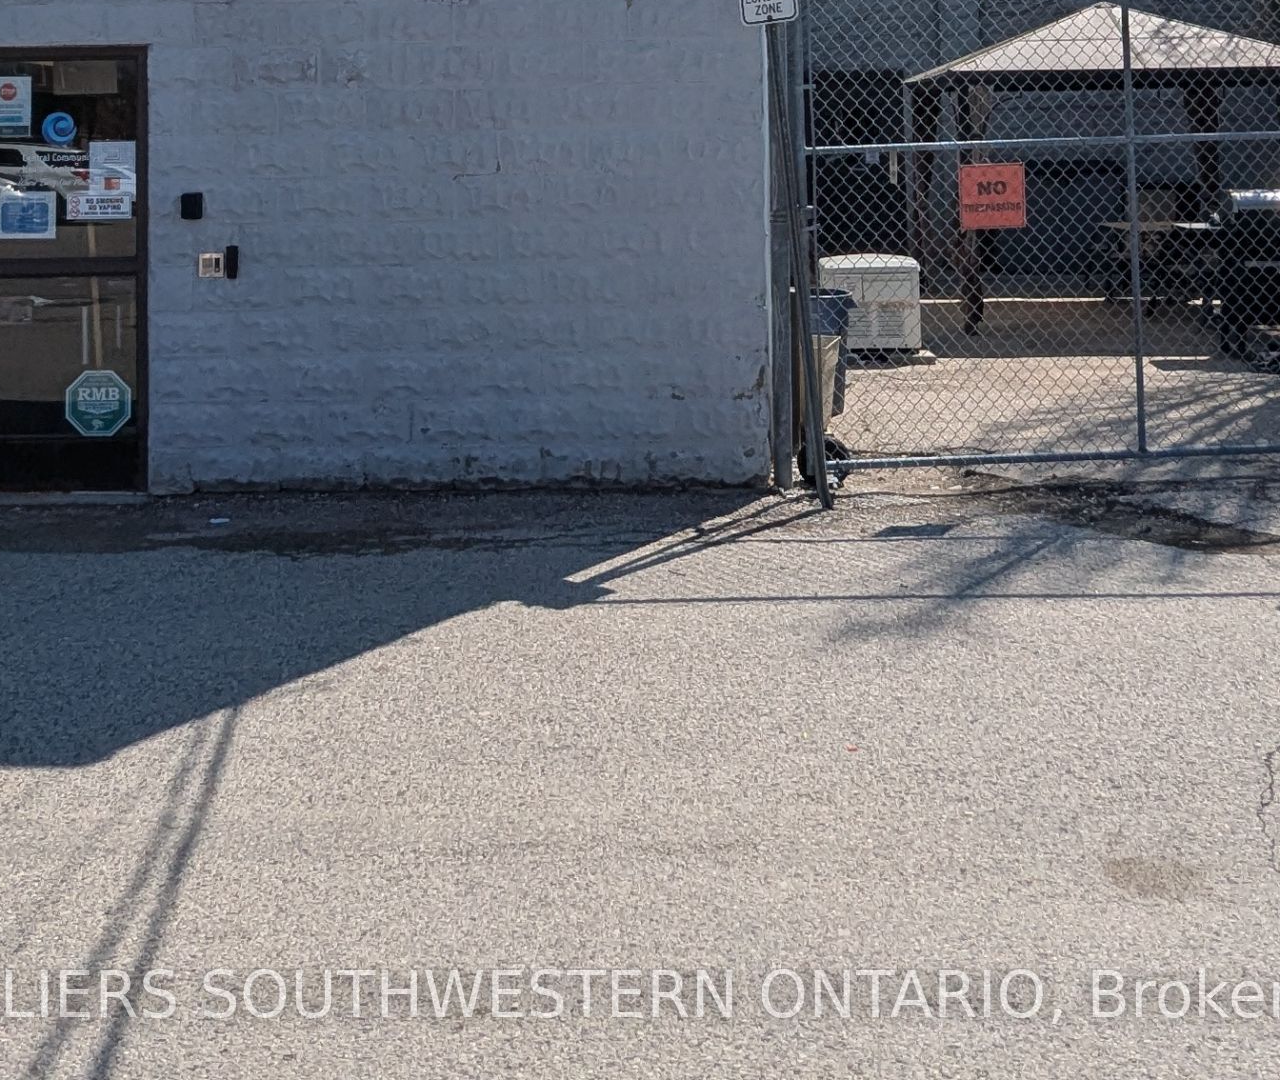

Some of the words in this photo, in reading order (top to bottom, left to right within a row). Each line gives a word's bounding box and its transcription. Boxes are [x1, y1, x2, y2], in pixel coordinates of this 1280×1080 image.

[754, 2, 783, 16] ZONE
[976, 180, 1008, 196] NO
[77, 386, 121, 401] RMB
